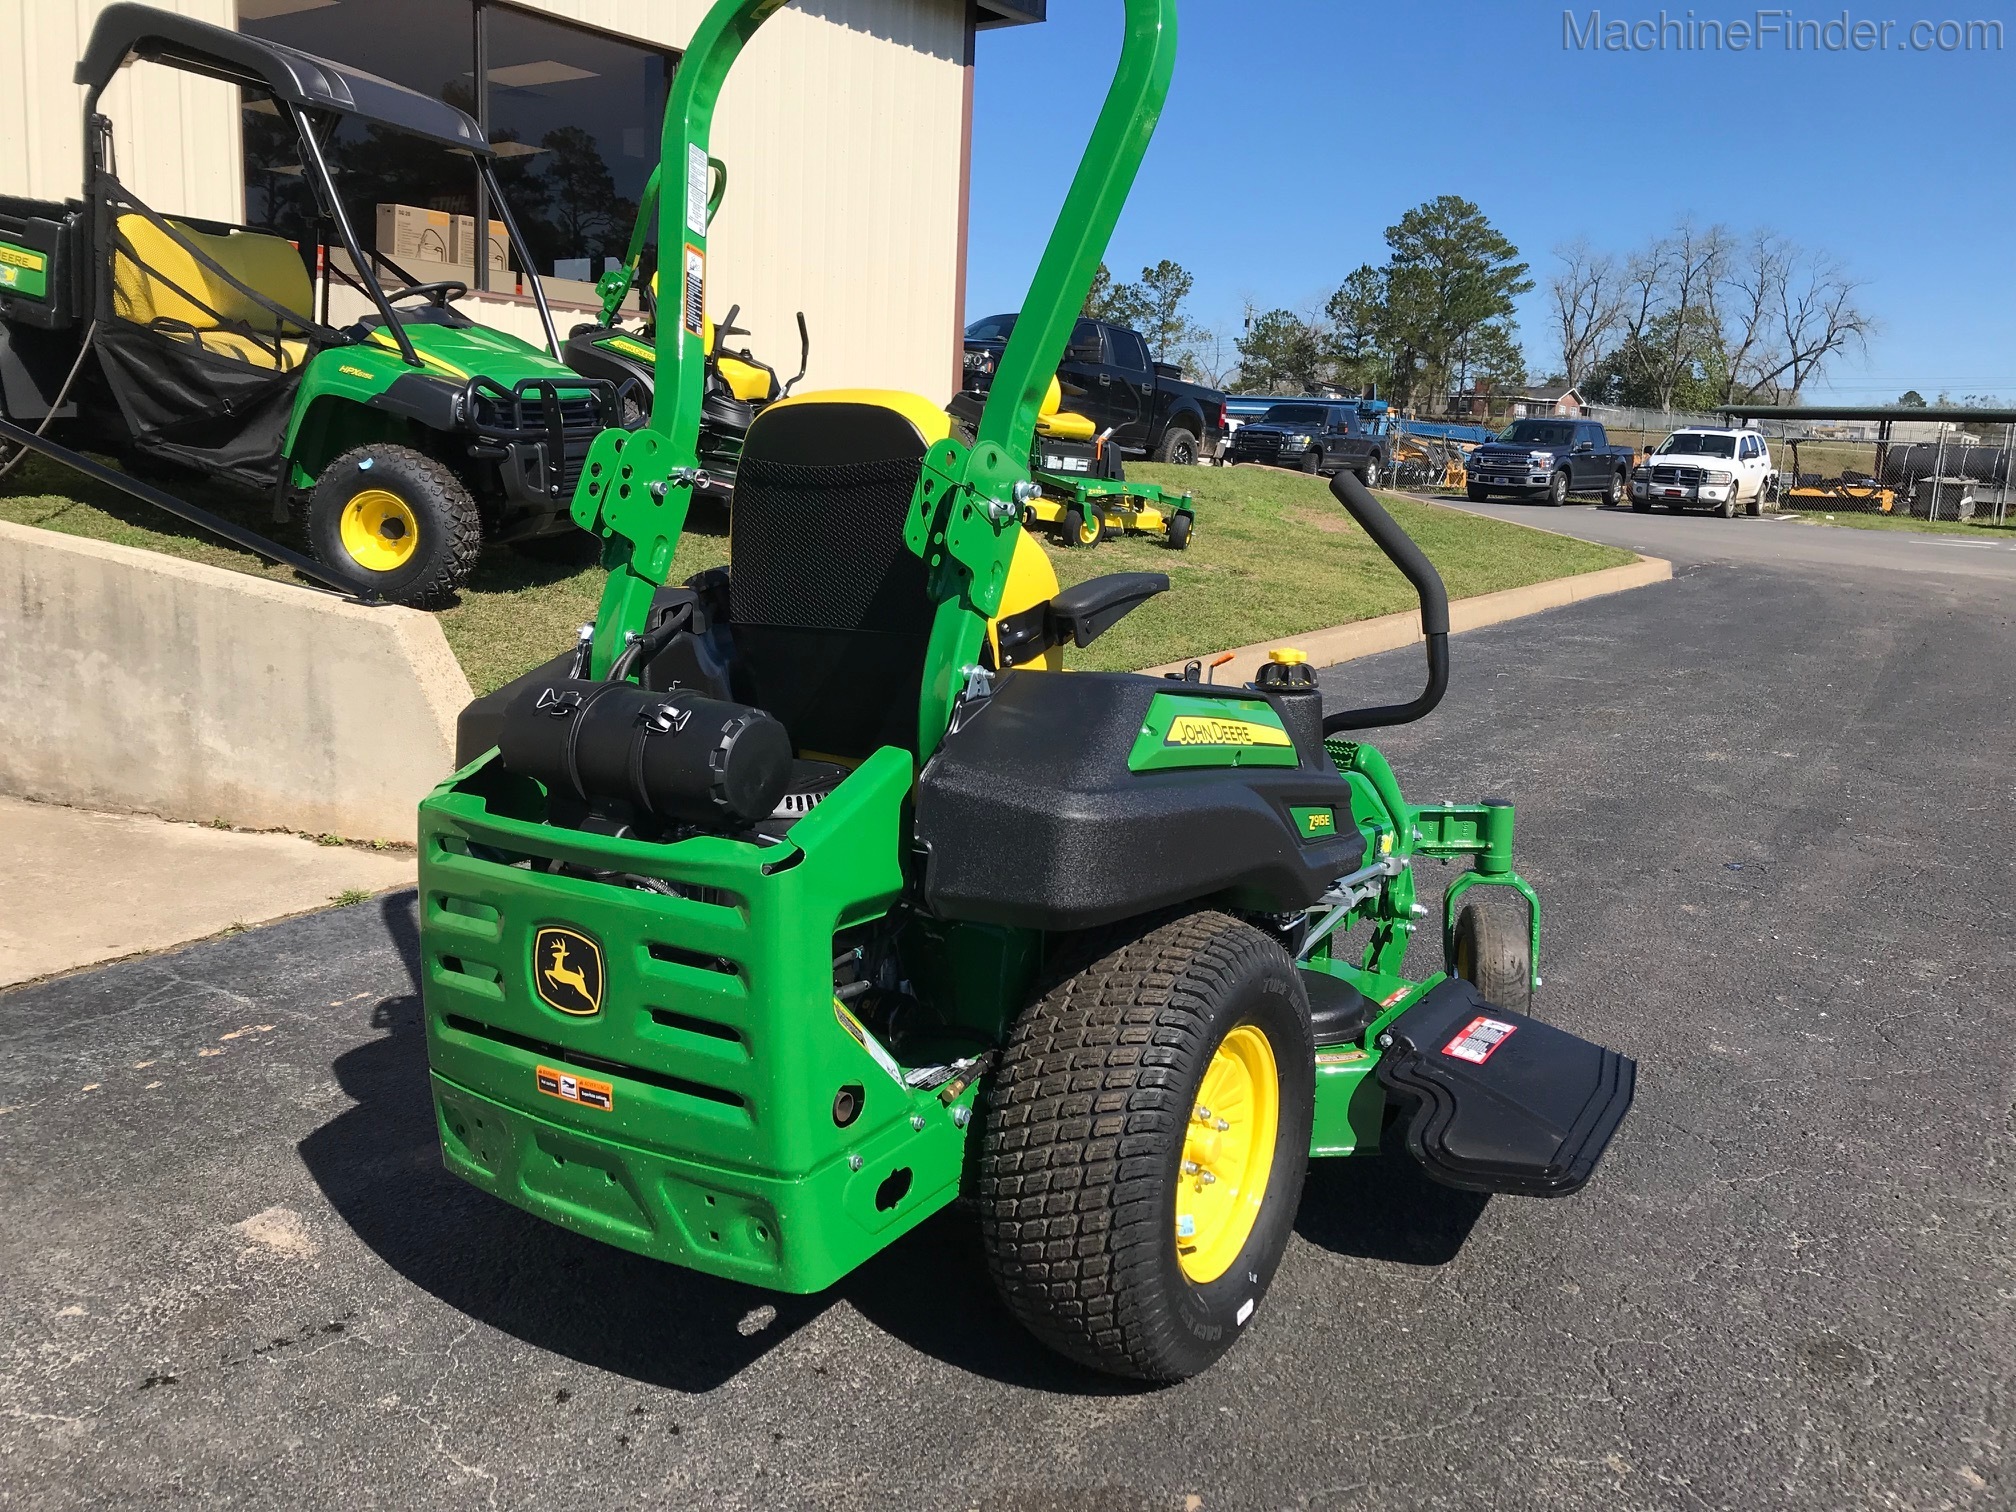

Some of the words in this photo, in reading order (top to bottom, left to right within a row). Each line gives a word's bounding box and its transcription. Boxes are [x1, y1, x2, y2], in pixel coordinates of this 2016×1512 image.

[0, 251, 29, 267] EERE
[1179, 720, 1213, 742] JOHN
[1210, 721, 1252, 742] DEERE
[1308, 814, 1330, 830] Z915E
